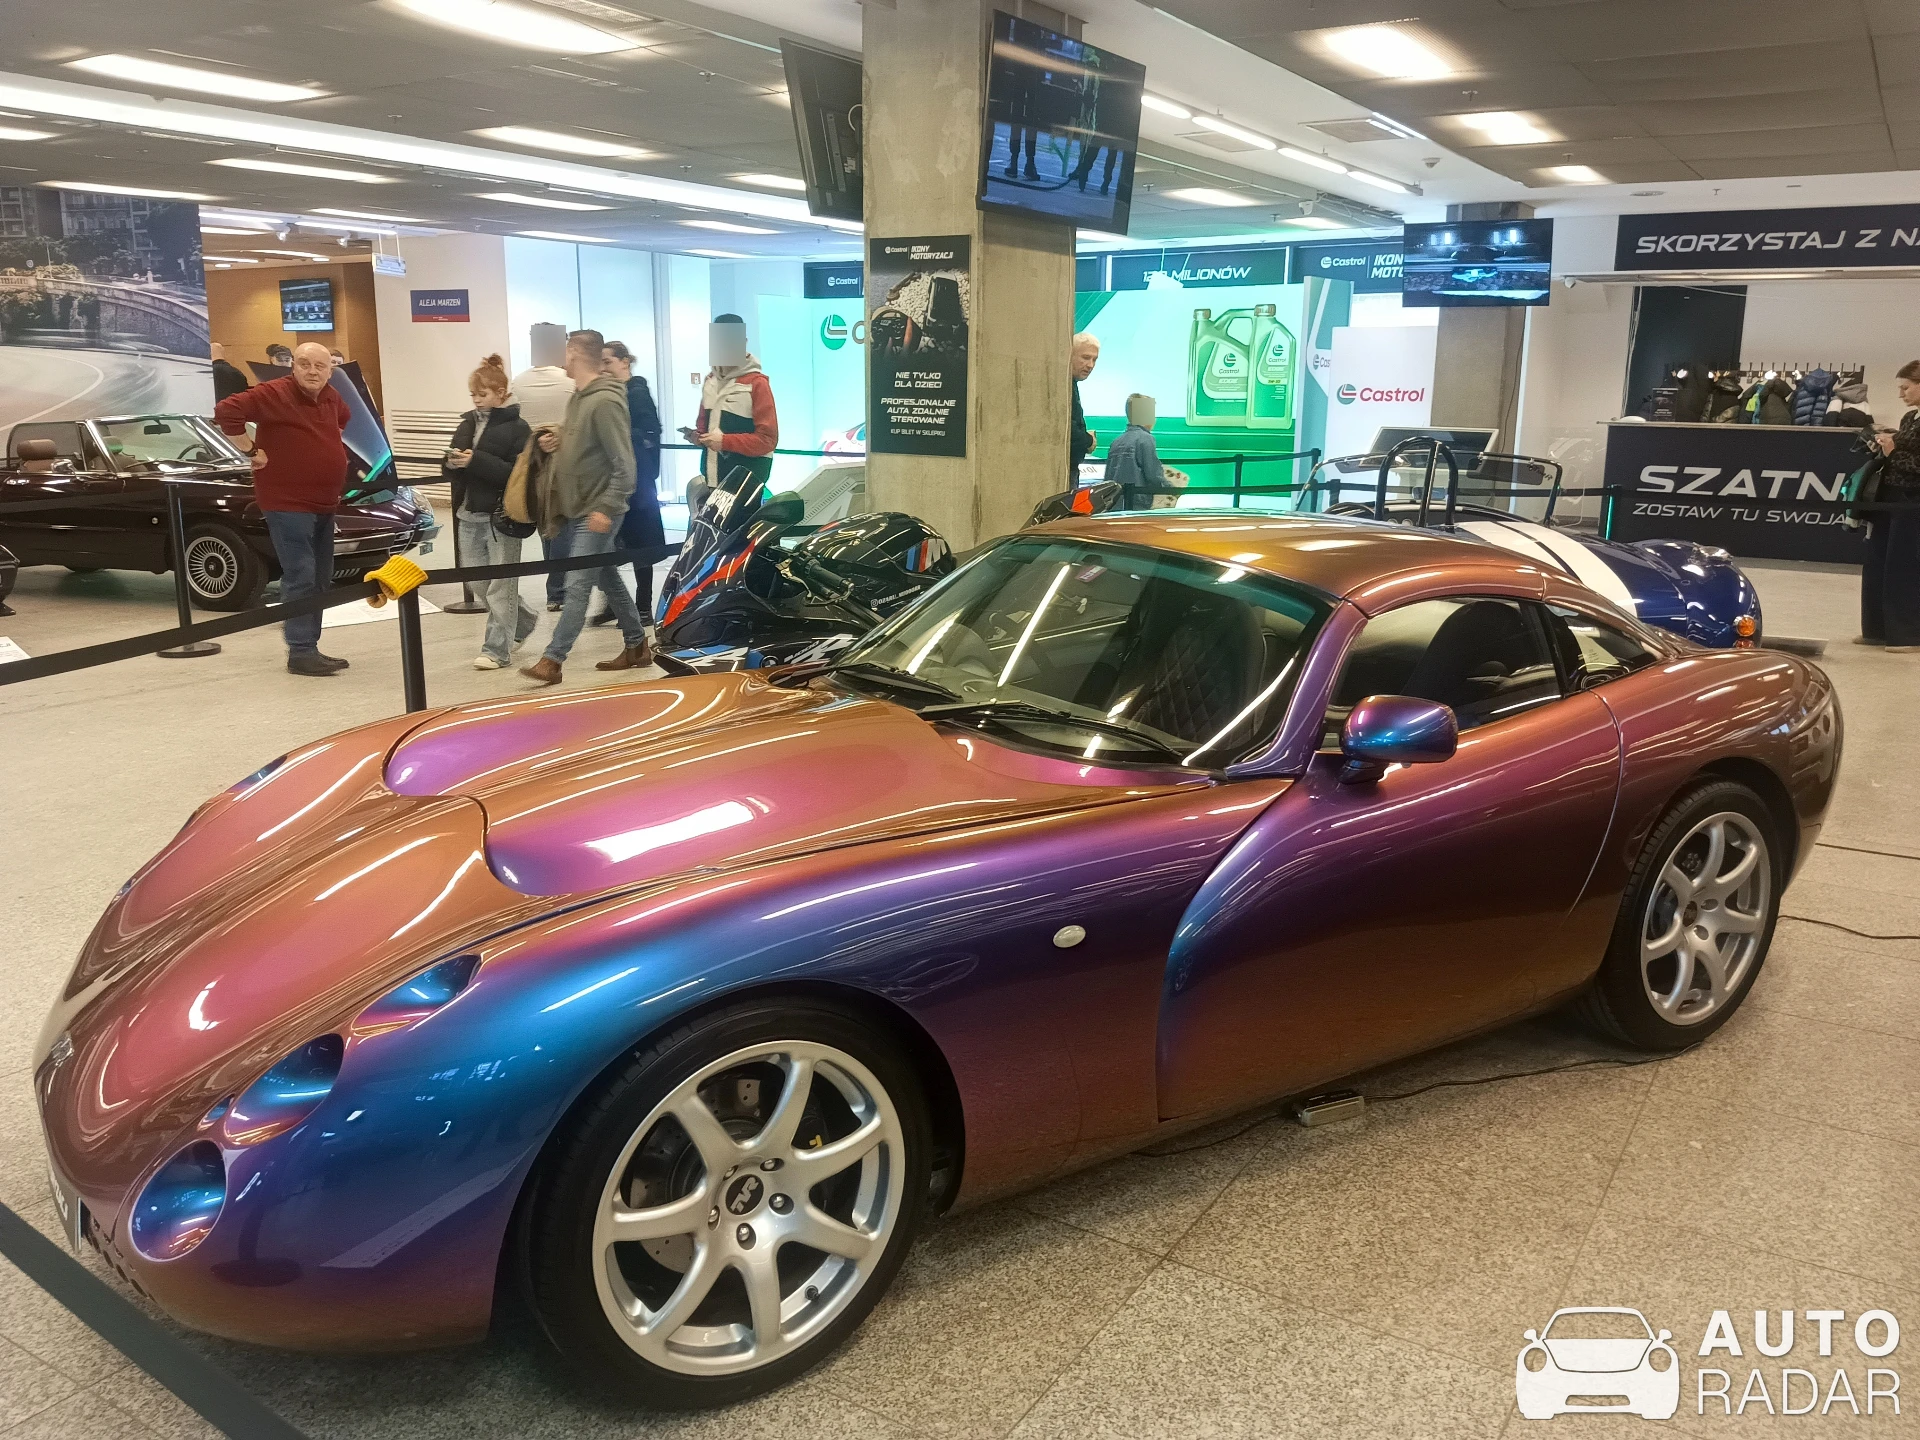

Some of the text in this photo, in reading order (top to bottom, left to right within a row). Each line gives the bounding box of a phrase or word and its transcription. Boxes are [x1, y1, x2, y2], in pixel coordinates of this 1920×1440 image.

[1636, 230, 1846, 253] SKORZYSTAJ
[1855, 229, 1882, 248] Z
[911, 245, 930, 253] IKONY
[910, 251, 954, 260] MOTORYZACJI
[1374, 254, 1404, 266] IKON
[1332, 257, 1366, 267] Castrol
[1171, 265, 1252, 281] MILIONÓW
[835, 277, 859, 285] Castrol
[895, 371, 941, 380] NIE TYLKO
[894, 380, 943, 389] DLA DZIECI
[1360, 387, 1425, 402] Castrol
[880, 397, 957, 407] PROFESJONALNE
[886, 406, 950, 416] AUTA ZDALNIE
[890, 415, 946, 425] STEROWANE
[1636, 465, 1847, 502] SZATN
[1632, 503, 1724, 519] ZOSTAW
[1730, 507, 1760, 521] TU
